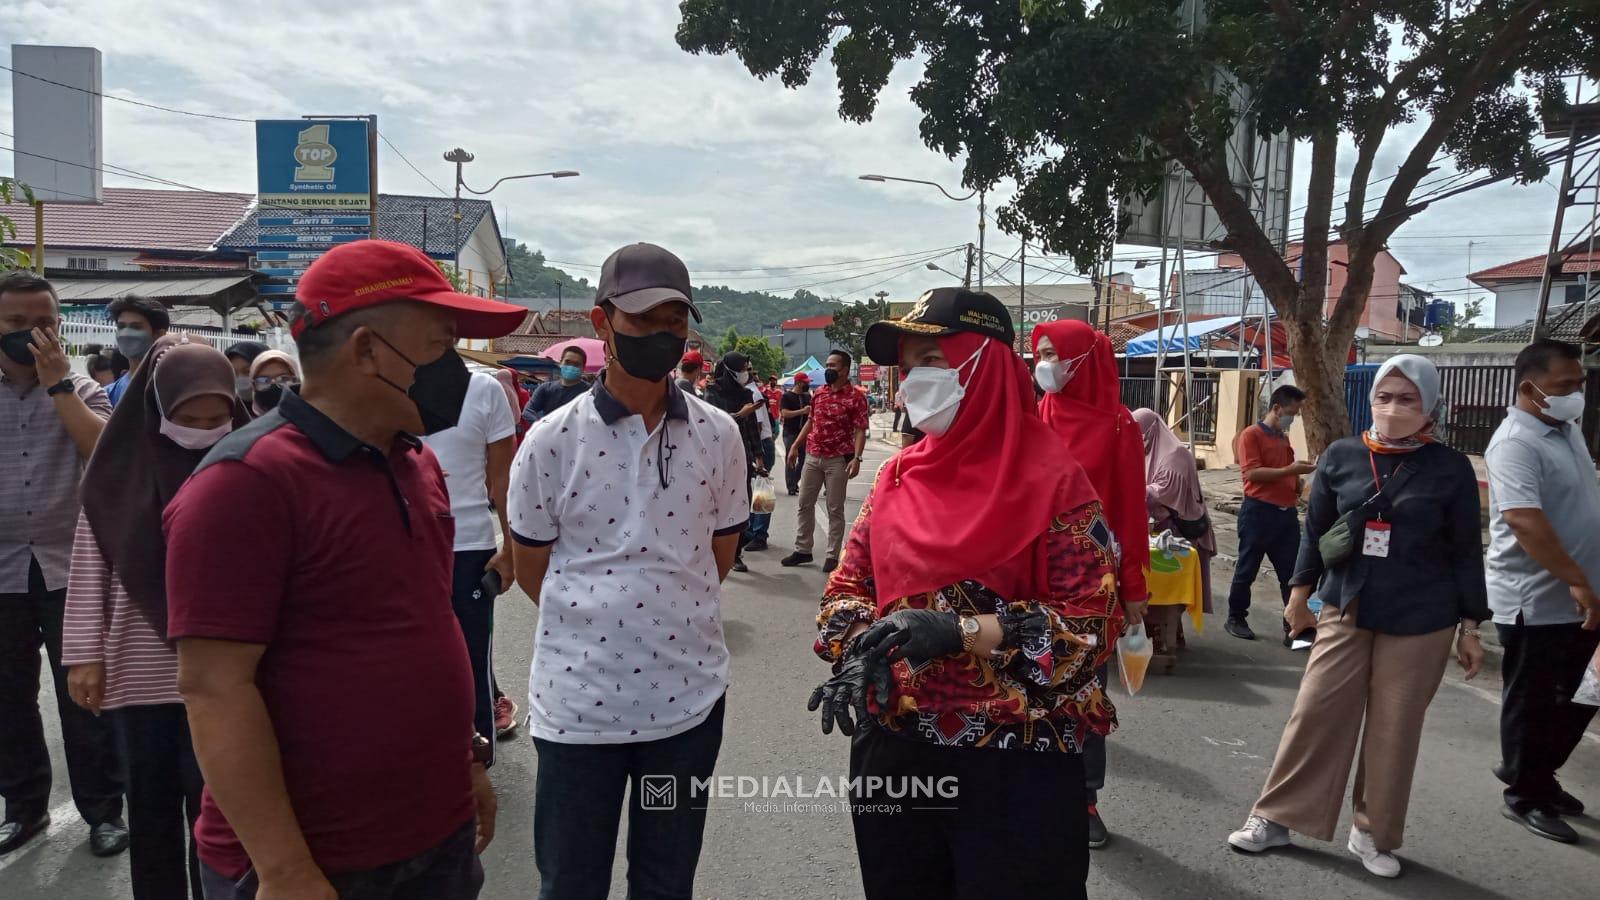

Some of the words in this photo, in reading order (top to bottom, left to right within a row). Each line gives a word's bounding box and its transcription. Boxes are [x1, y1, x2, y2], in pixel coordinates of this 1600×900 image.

[300, 148, 332, 161] TOP
[289, 183, 325, 191] Synthetic
[262, 198, 299, 206] BINTANG
[967, 310, 1000, 324] WALIKOTA
